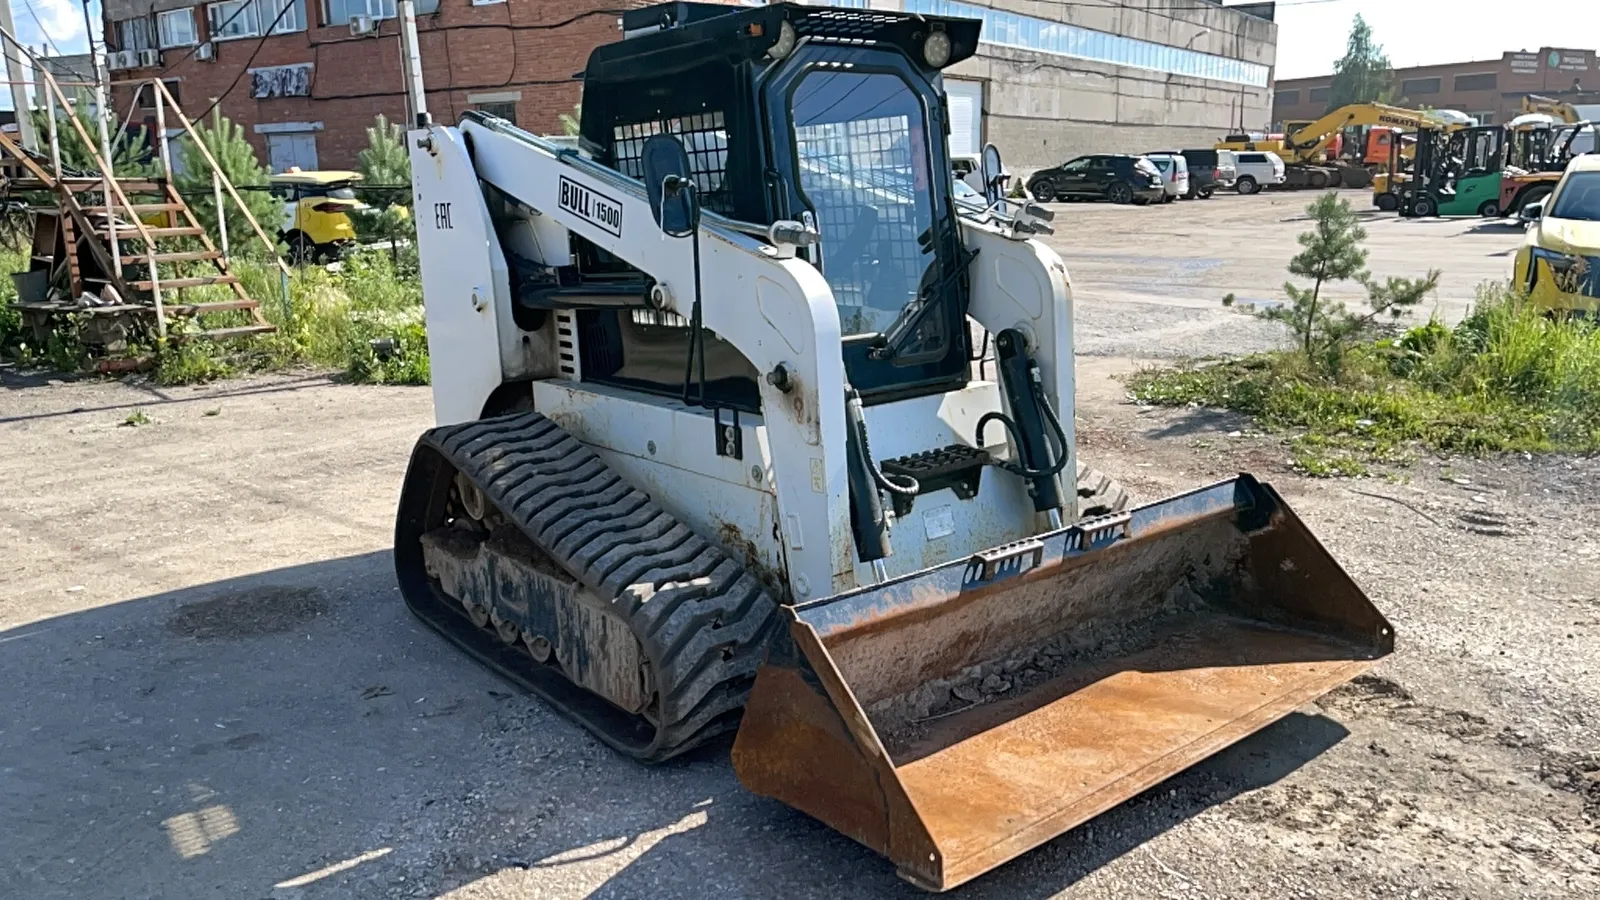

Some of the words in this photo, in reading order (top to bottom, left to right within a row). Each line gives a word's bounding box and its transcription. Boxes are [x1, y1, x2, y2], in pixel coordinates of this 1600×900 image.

[1379, 115, 1421, 127] KOMATSU
[561, 181, 590, 217] BULL
[596, 202, 619, 228] 1500
